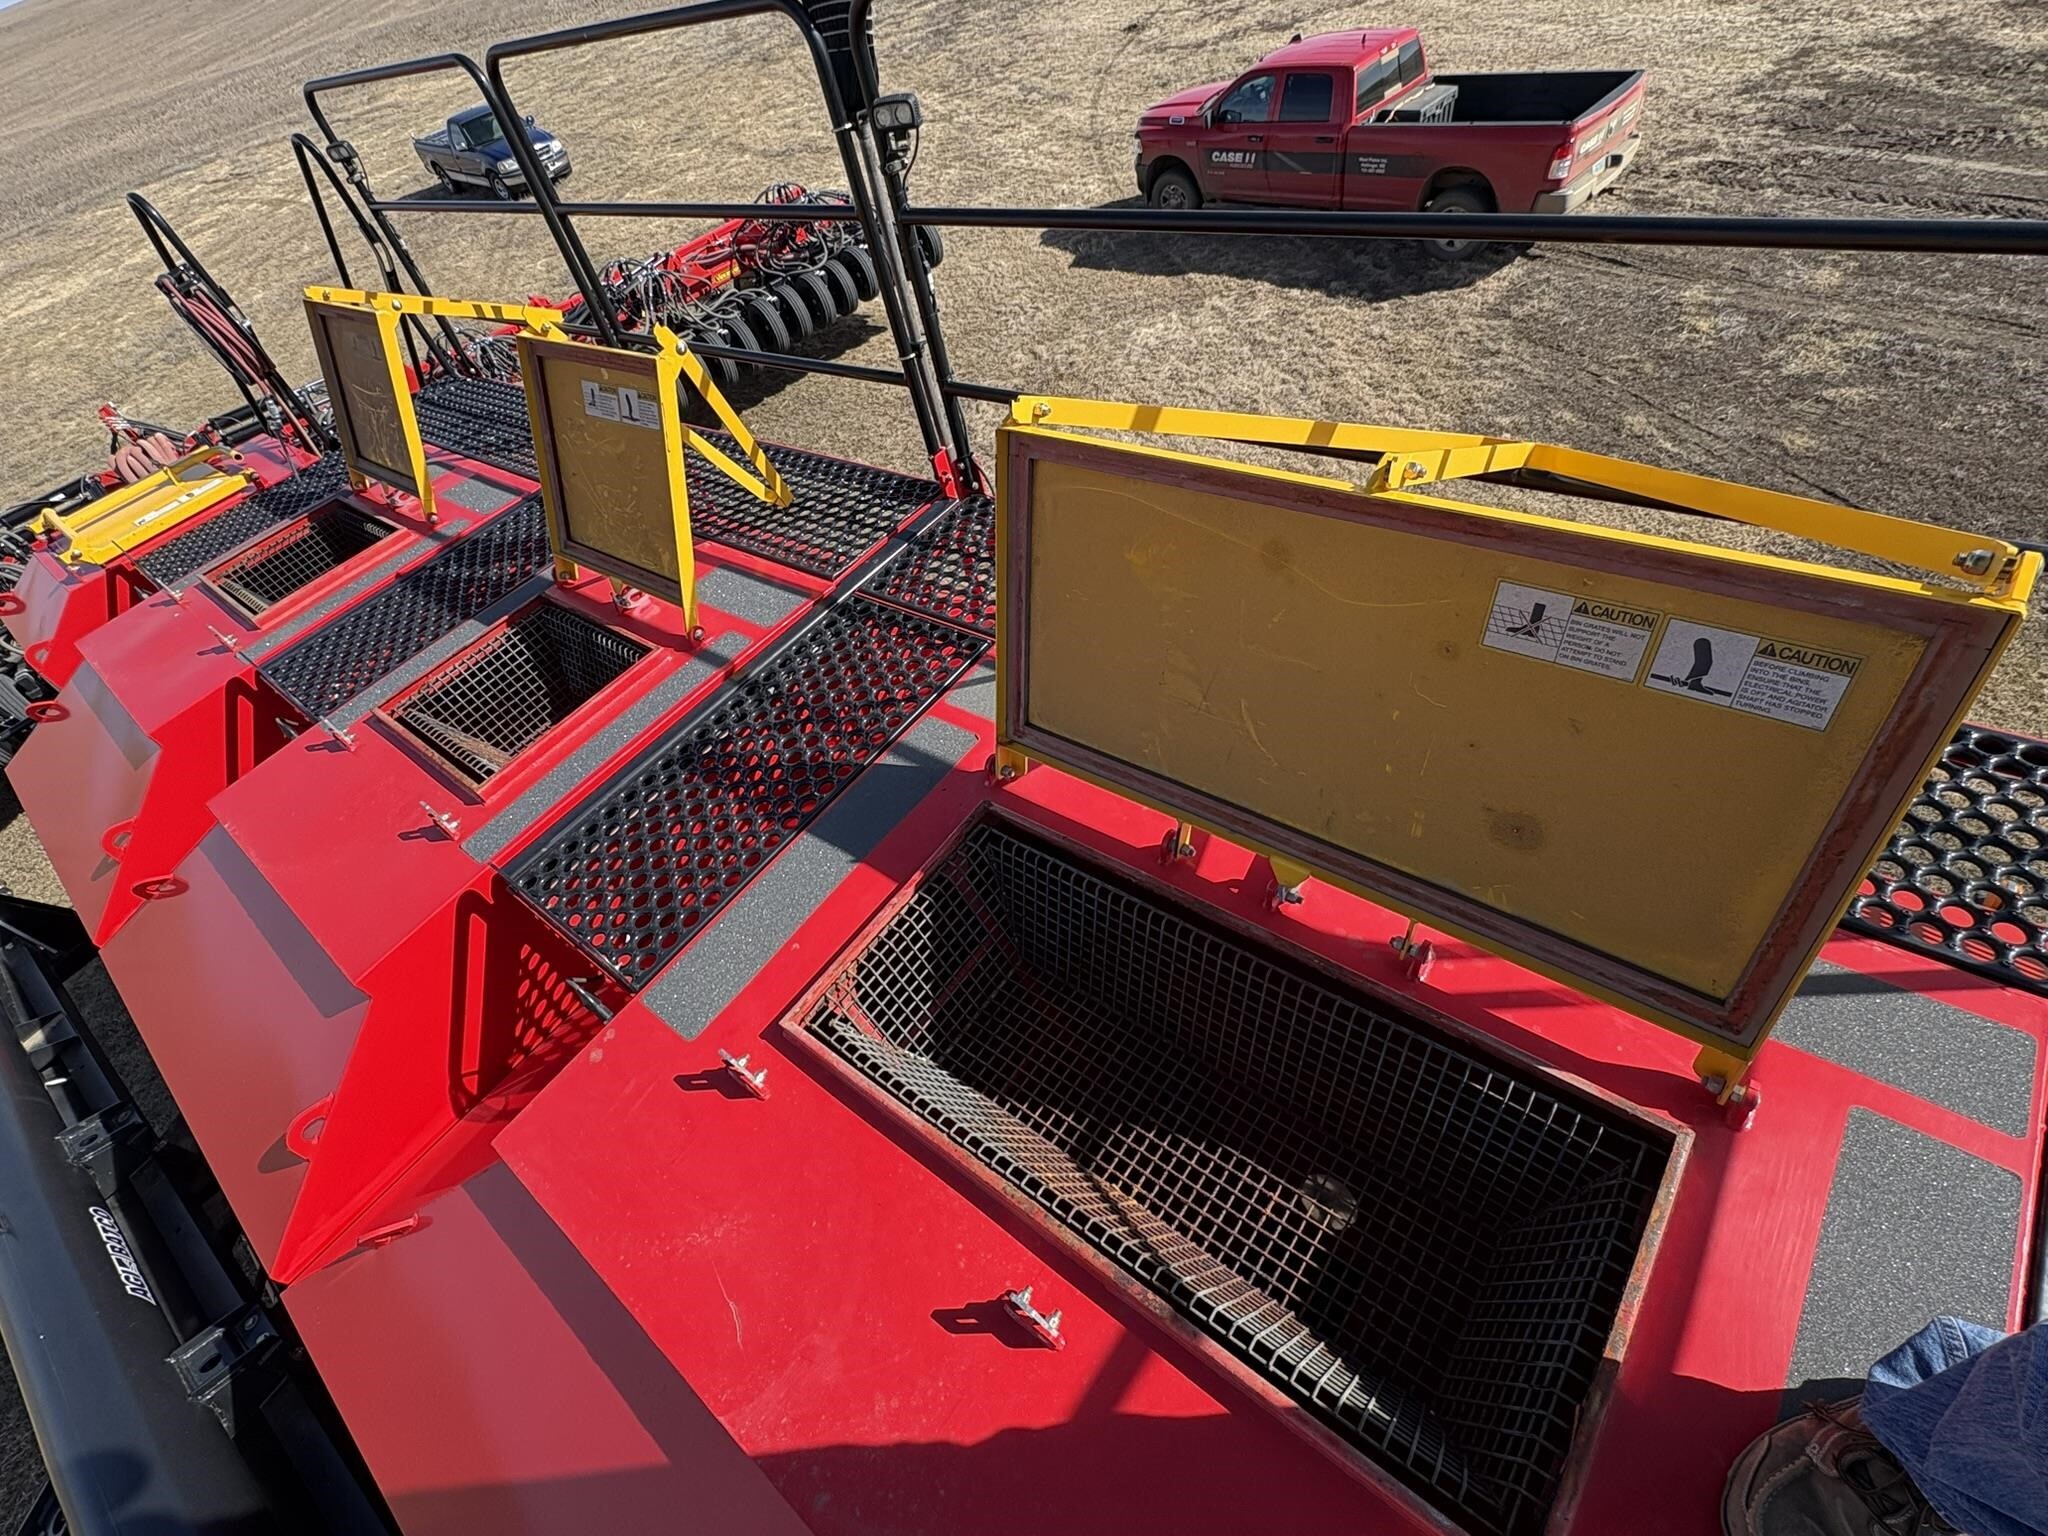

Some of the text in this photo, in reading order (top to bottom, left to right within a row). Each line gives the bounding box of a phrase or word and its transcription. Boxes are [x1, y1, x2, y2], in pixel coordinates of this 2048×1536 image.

[1212, 151, 1244, 163] CASE
[1591, 605, 1655, 629] CAUTION
[1566, 633, 1592, 643] WEIGHT
[1568, 626, 1616, 642] SUPPORT THE
[1583, 622, 1611, 634] GRATES
[1612, 628, 1628, 638] WILL
[1630, 632, 1646, 642] NOT
[1561, 646, 1592, 658] ATTEMPT
[1604, 656, 1627, 667] STAND
[1594, 646, 1605, 654] DO
[1606, 649, 1622, 658] NOT
[1778, 646, 1858, 674] CAUTION
[1750, 667, 1770, 676] INTO
[1771, 672, 1787, 680] THE
[1753, 660, 1830, 683] BEFORE CLIMBING
[1744, 681, 1828, 705] ELECTRICAL POWER
[1747, 674, 1822, 696] ENSURE THAT THE
[1738, 694, 1824, 720] SHAFT HAS STOPPED
[1750, 689, 1768, 698] OFF
[1769, 694, 1786, 703] AND
[1787, 699, 1828, 713] AGITATOR
[88, 1206, 135, 1262] BATCO
